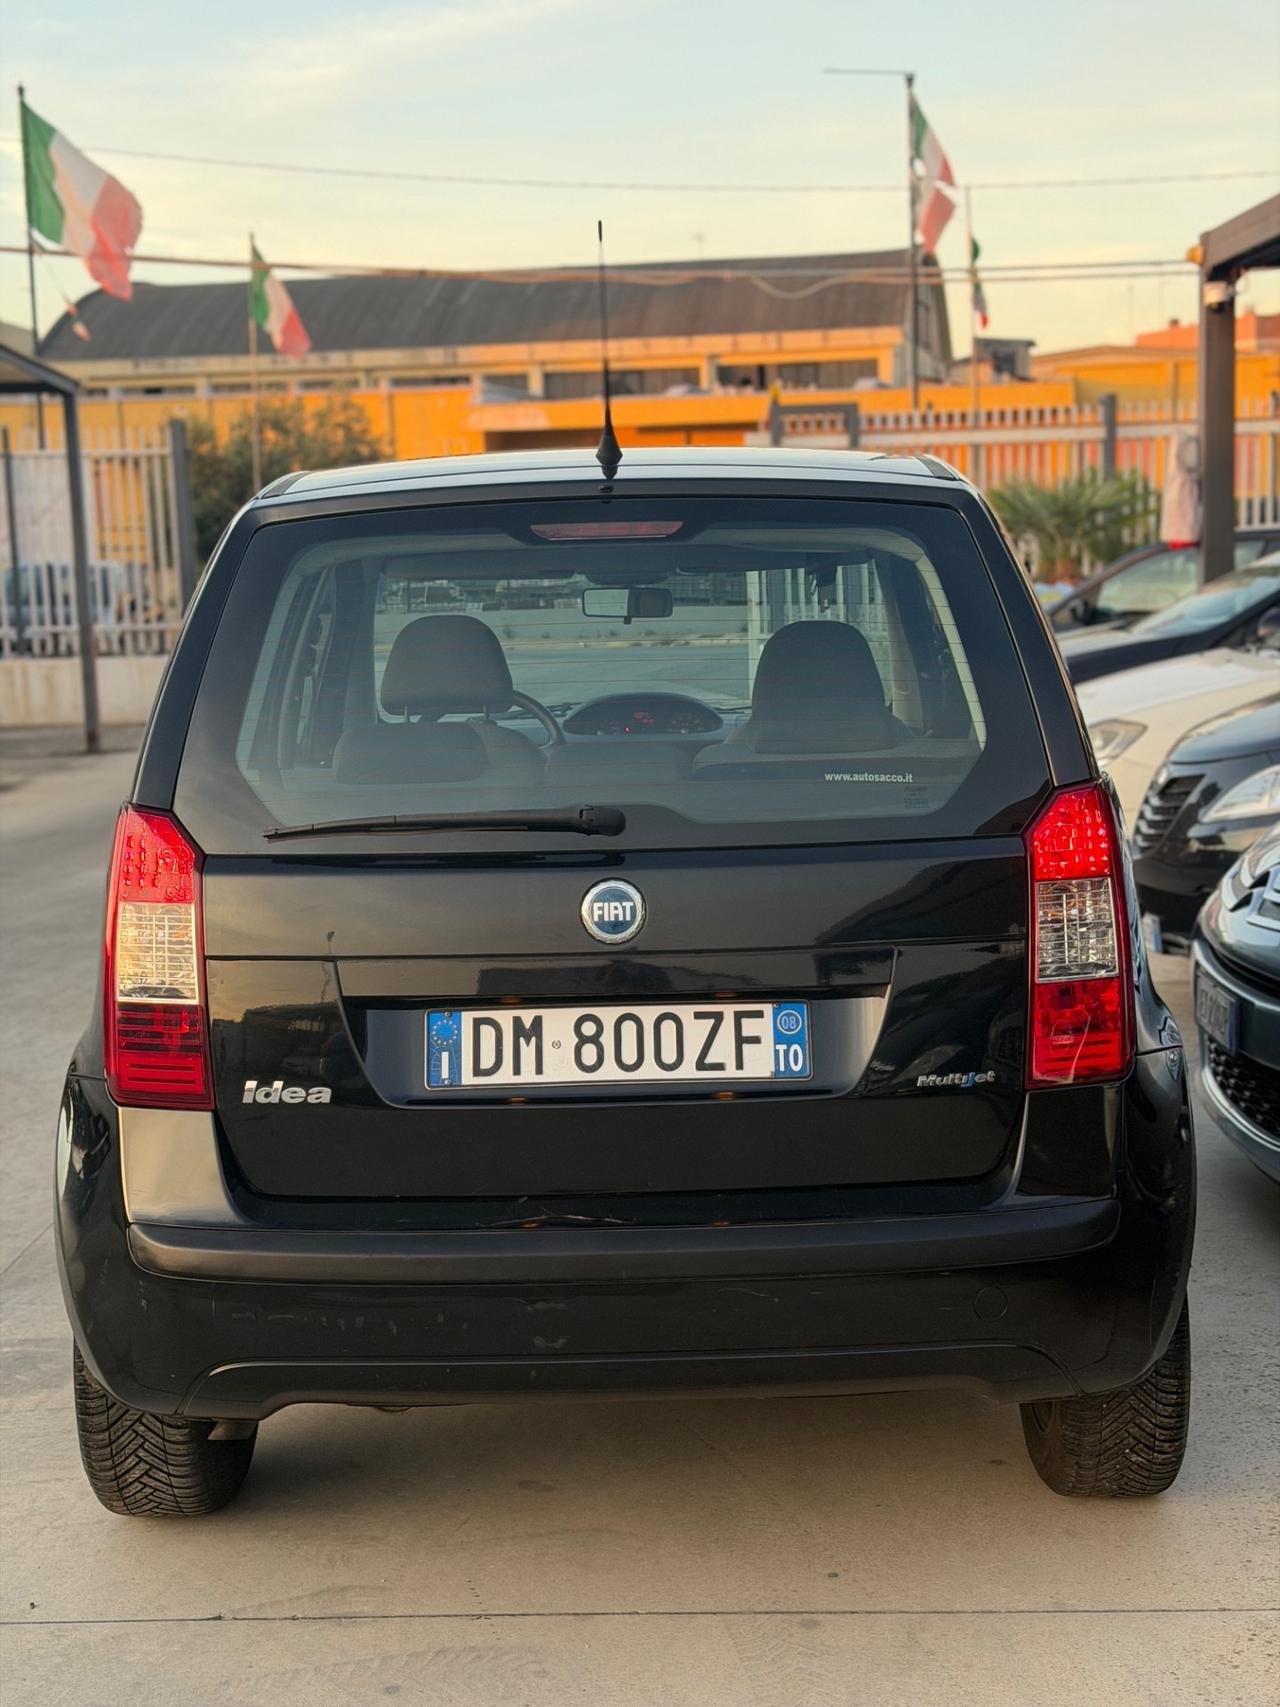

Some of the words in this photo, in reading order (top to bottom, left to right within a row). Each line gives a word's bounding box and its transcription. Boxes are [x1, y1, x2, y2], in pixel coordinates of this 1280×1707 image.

[824, 772, 913, 783] www.autosacco.it
[593, 901, 634, 922] FIAT
[781, 1015, 797, 1030] 08
[472, 1014, 544, 1078] DM
[573, 1010, 765, 1074] 800ZF
[775, 1043, 804, 1072] TO
[242, 1080, 332, 1104] Idea
